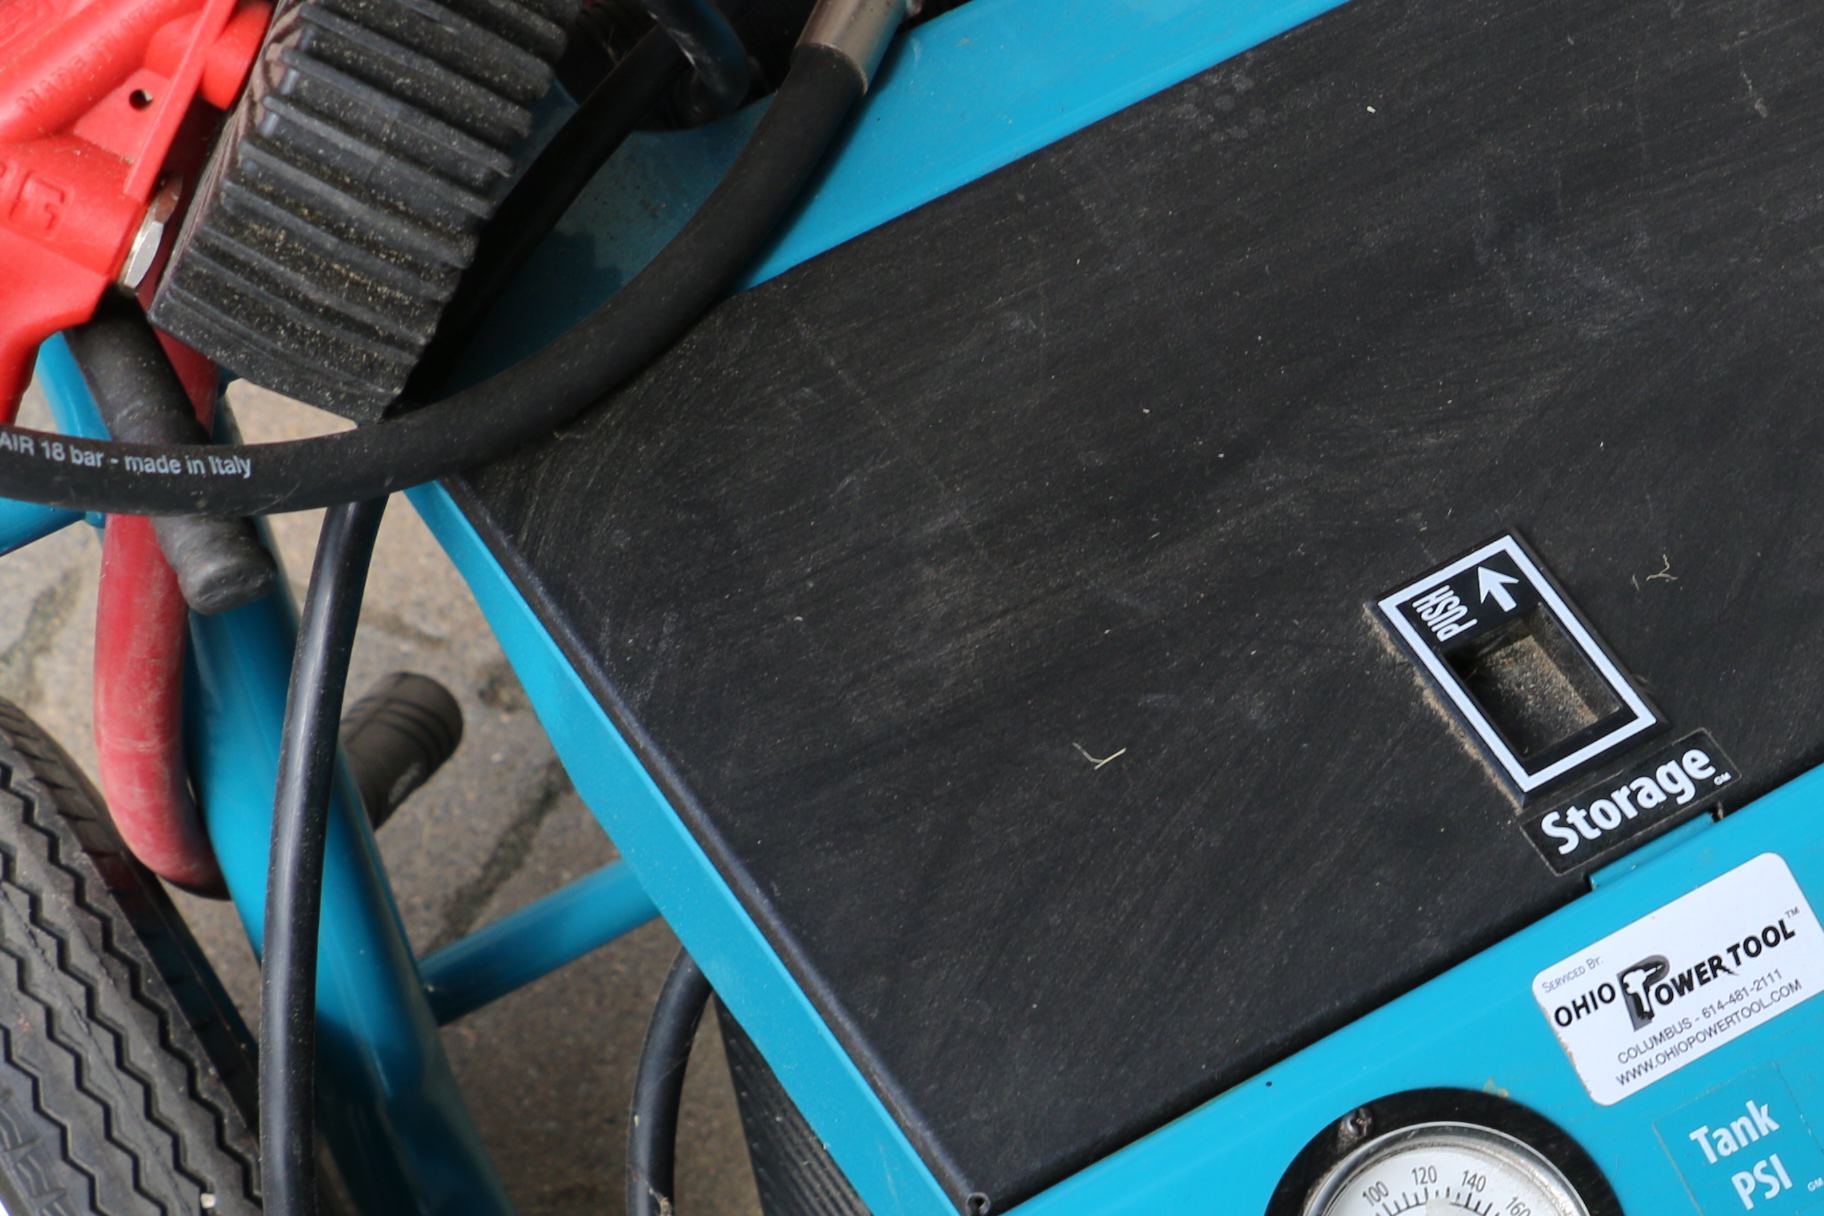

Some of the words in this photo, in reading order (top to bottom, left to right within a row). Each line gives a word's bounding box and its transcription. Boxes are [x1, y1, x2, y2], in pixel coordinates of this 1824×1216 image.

[0, 432, 34, 456] AIR
[41, 441, 66, 461] 18
[71, 445, 104, 467] bar
[125, 454, 182, 474] made
[185, 455, 206, 475] in
[208, 455, 251, 478] Italy
[1412, 584, 1478, 642] PUSH
[1541, 748, 1717, 855] Storage
[1554, 982, 1616, 1028] OHIO
[1727, 918, 1796, 967] TOOL
[1615, 979, 1803, 1087] WWW.OHIOPOWERTOOL.COM
[1617, 1017, 1693, 1065] COLUMBUS
[1702, 968, 1783, 1020] 614-481-2111
[1689, 1099, 1780, 1164] Tank
[1362, 1181, 1389, 1207] 100
[1412, 1165, 1438, 1185] 120
[1461, 1170, 1486, 1192] 140
[1731, 1153, 1793, 1211] PSI
[1807, 1177, 1824, 1192] GM
